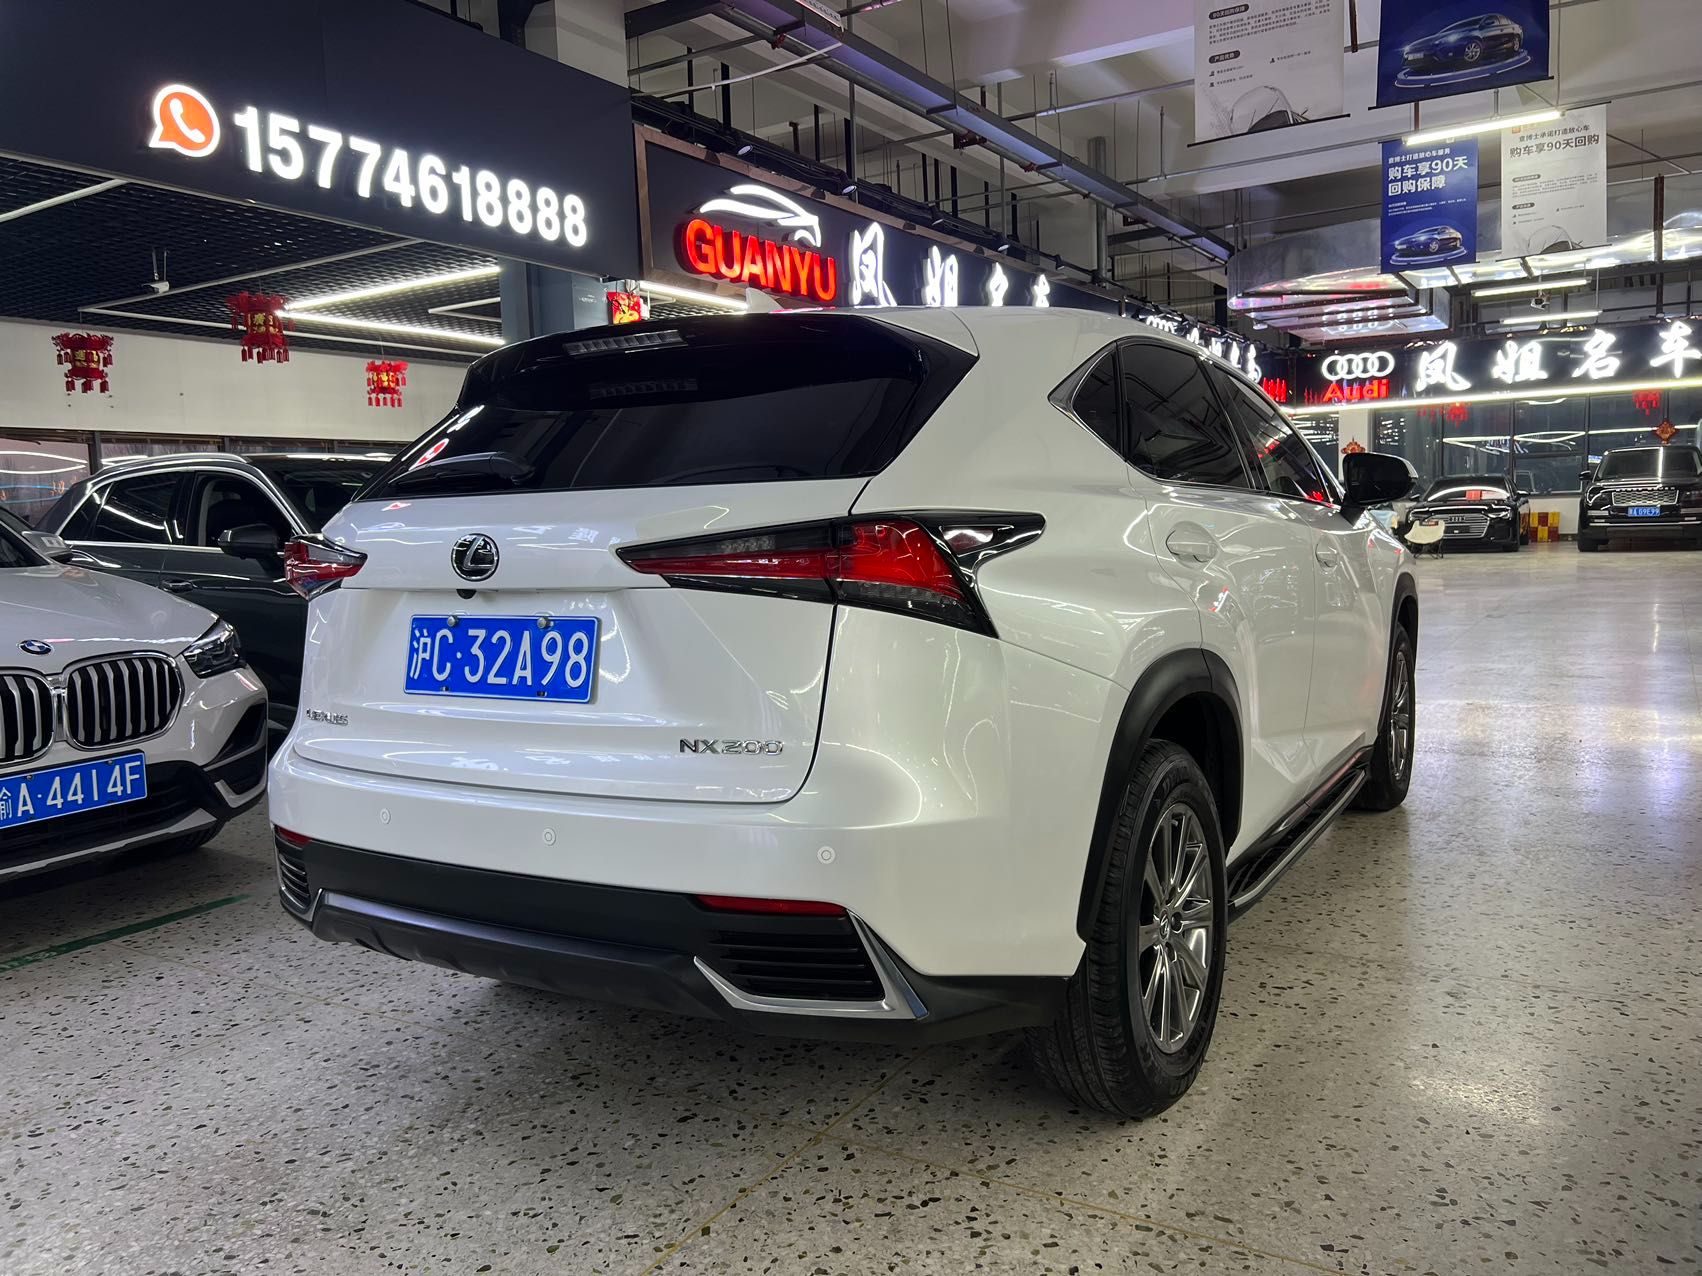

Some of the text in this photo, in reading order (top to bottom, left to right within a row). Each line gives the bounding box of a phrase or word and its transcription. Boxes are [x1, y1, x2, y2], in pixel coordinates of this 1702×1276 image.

[1510, 134, 1600, 158] 购车享90天回购
[233, 106, 587, 247] 15774618888
[1388, 156, 1468, 181] 购车享90天
[1388, 175, 1446, 196] 回购保障
[682, 218, 837, 301] GUANYU
[1414, 320, 1702, 392] 凤姐名车
[1322, 378, 1390, 402] Audi
[409, 628, 589, 688] 沪C·32A98
